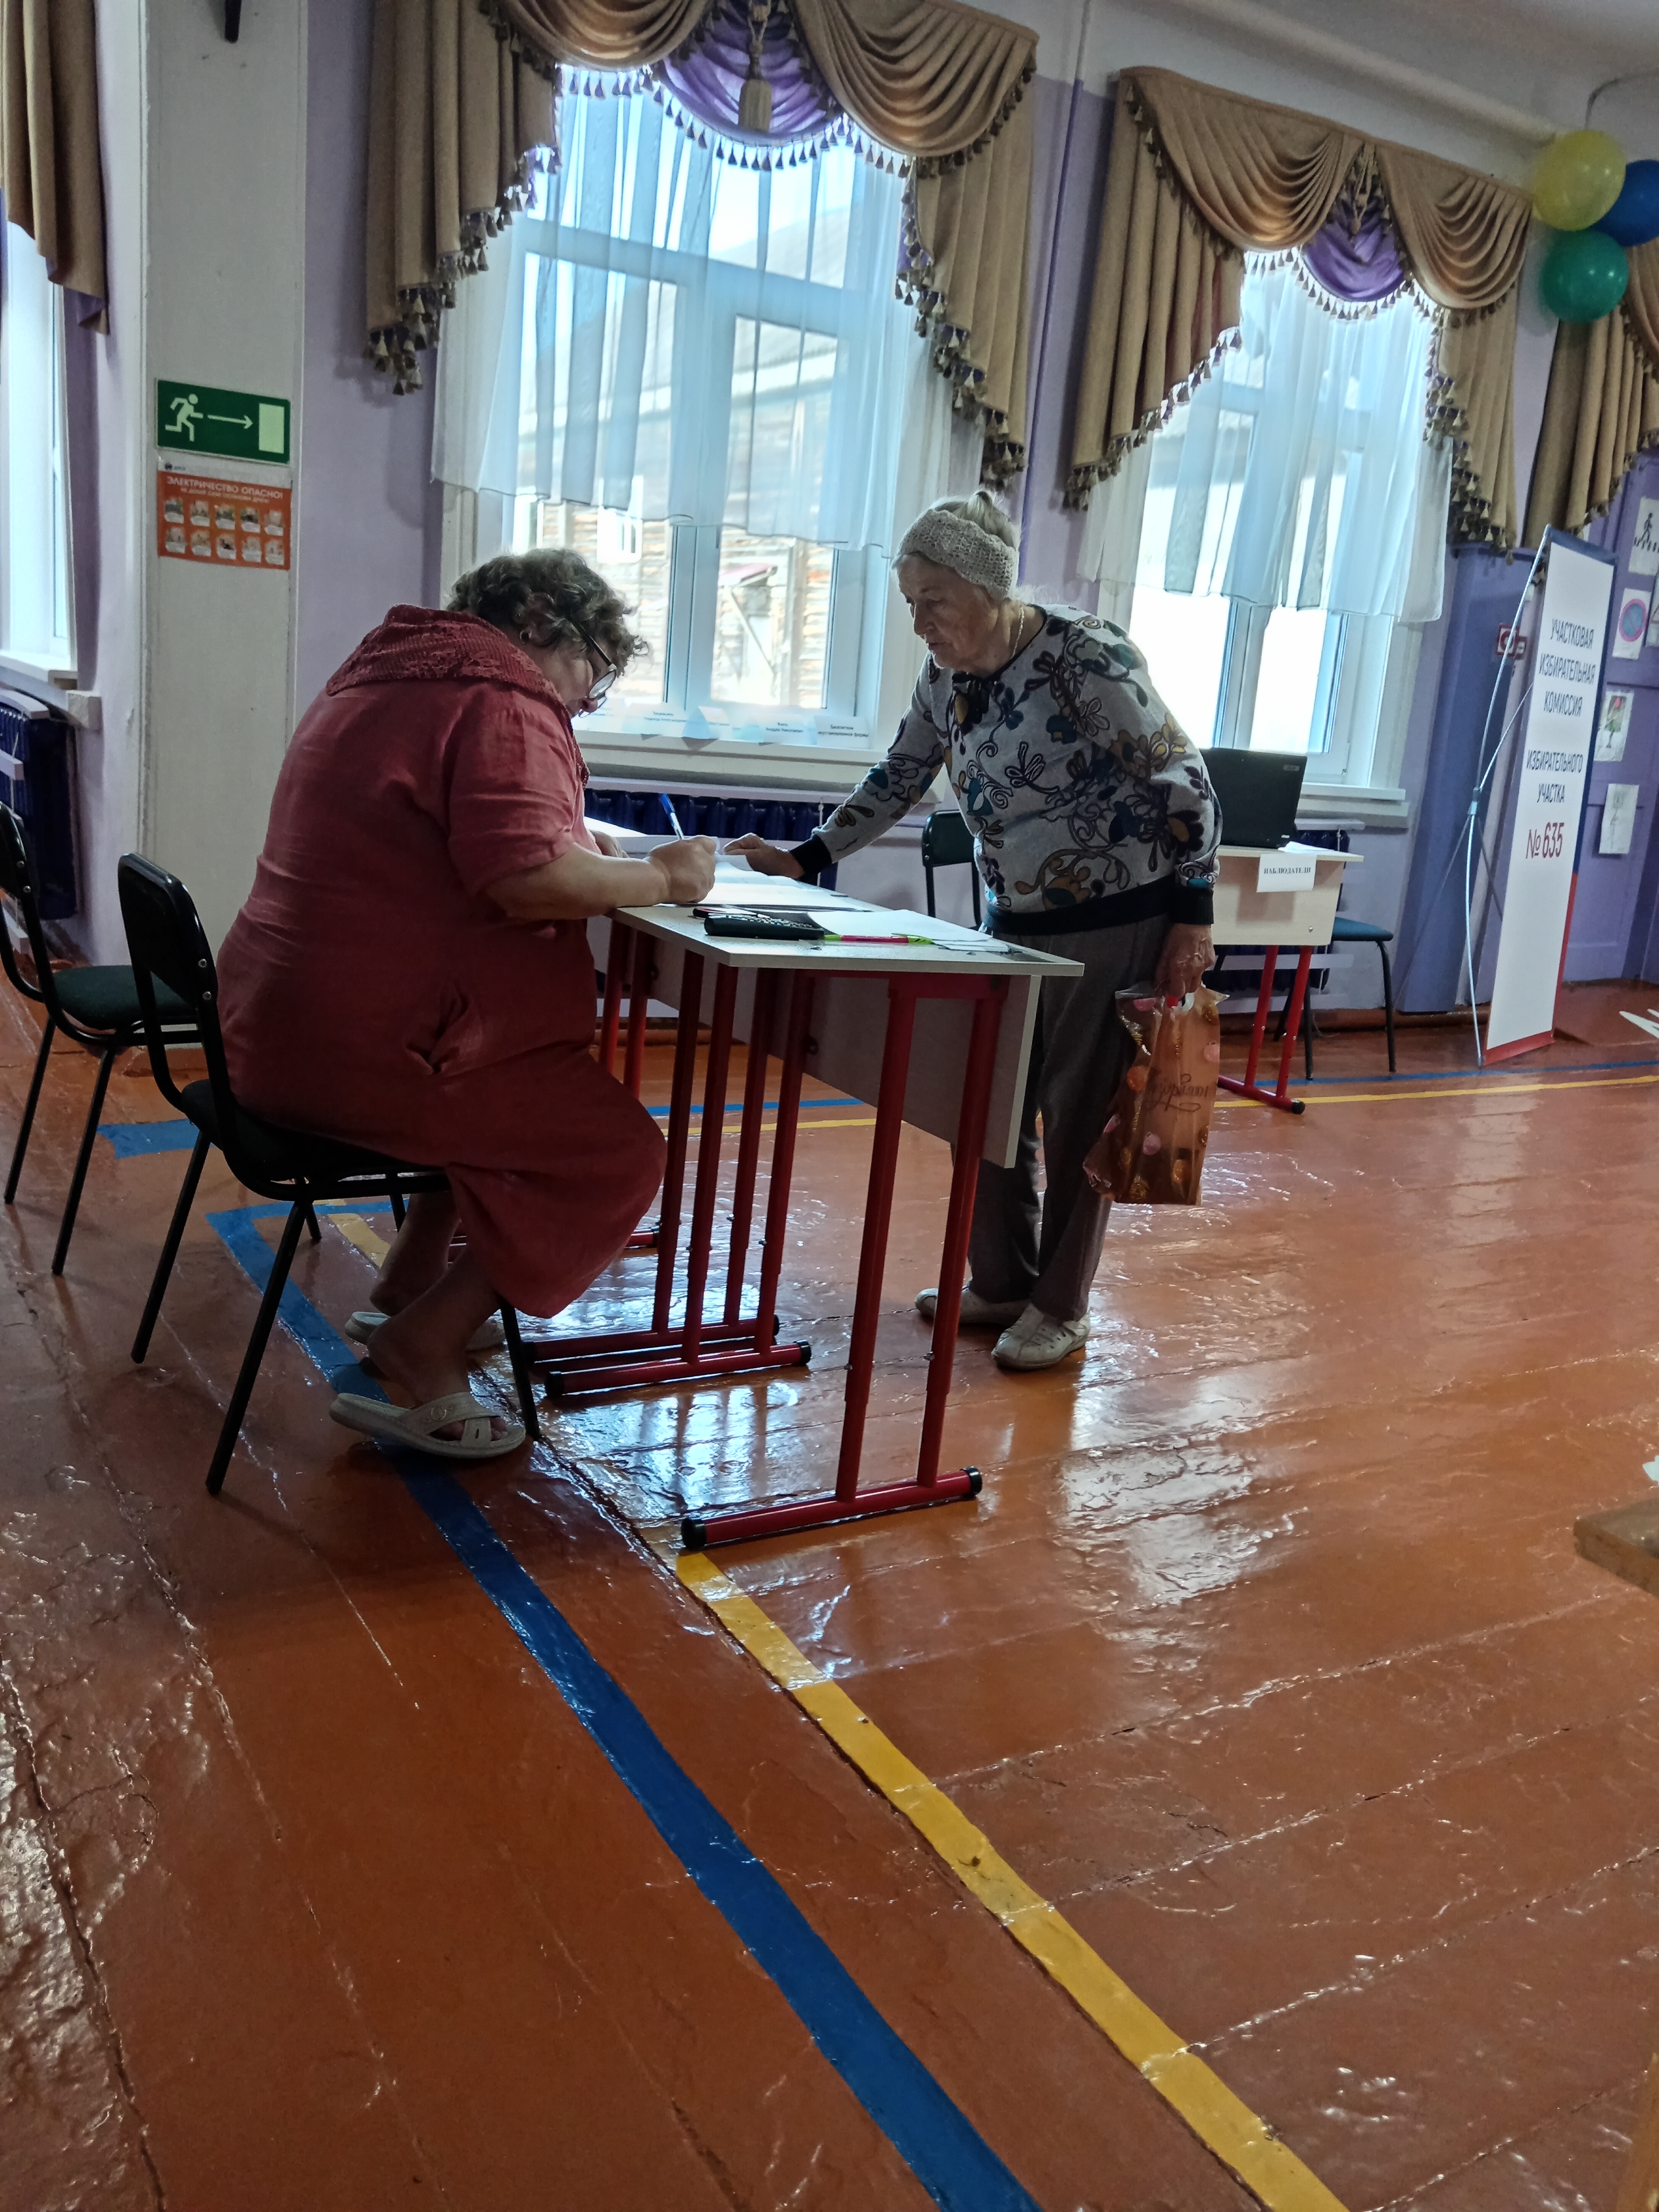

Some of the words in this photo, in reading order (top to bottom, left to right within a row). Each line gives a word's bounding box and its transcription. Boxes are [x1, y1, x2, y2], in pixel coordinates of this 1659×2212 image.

[167, 475, 239, 493] ЭЛЕКТРИЧЕСТВО
[241, 486, 283, 499] ОПАСНО!
[1551, 618, 1594, 649] УЧАСТКОВАЯ
[1539, 653, 1596, 685] ИЗБИРАТЕЛЬНАЯ
[1543, 690, 1583, 717] КОМИССИЯ
[1526, 750, 1583, 773] ИЗБИРАТЕЛЬНОГО
[1537, 784, 1565, 803] УЧАСТКА
